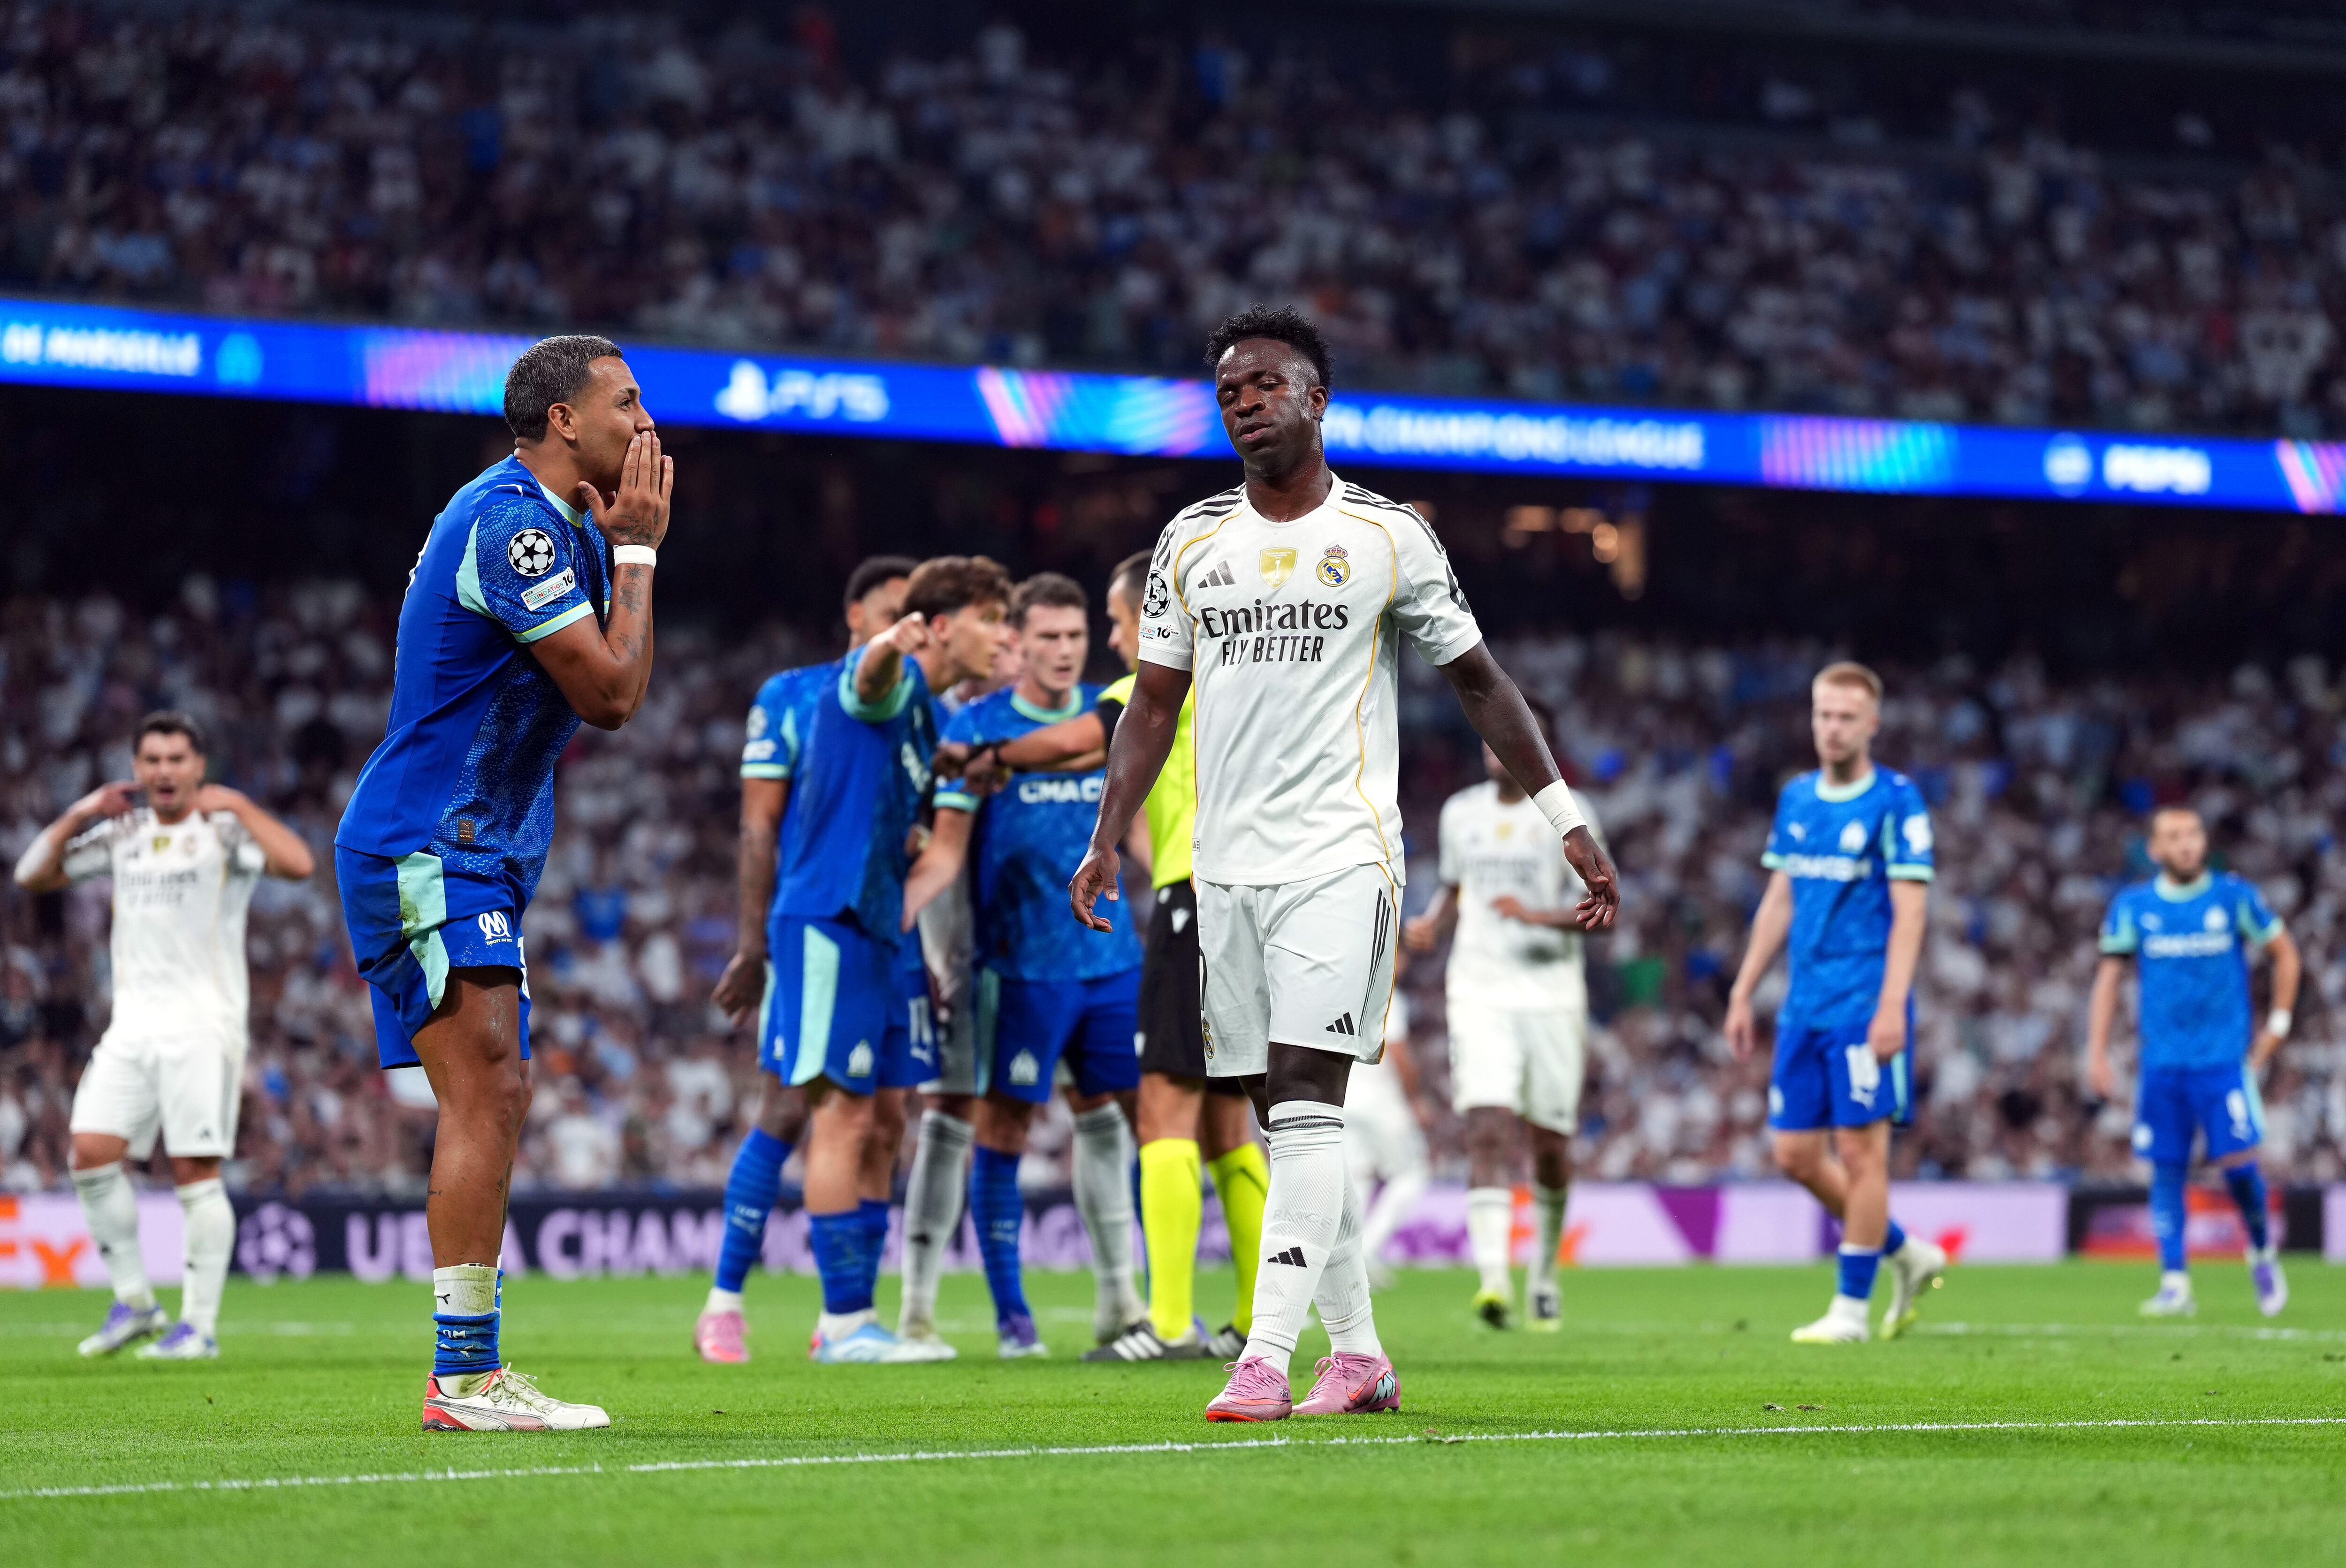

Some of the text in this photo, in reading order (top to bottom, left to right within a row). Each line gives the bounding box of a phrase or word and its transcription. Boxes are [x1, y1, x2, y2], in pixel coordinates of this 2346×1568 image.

[526, 582, 564, 604] FOUNDATION
[1145, 585, 1161, 603] 15
[1200, 598, 1348, 639] Emirates
[1222, 636, 1325, 666] FLY BETTER
